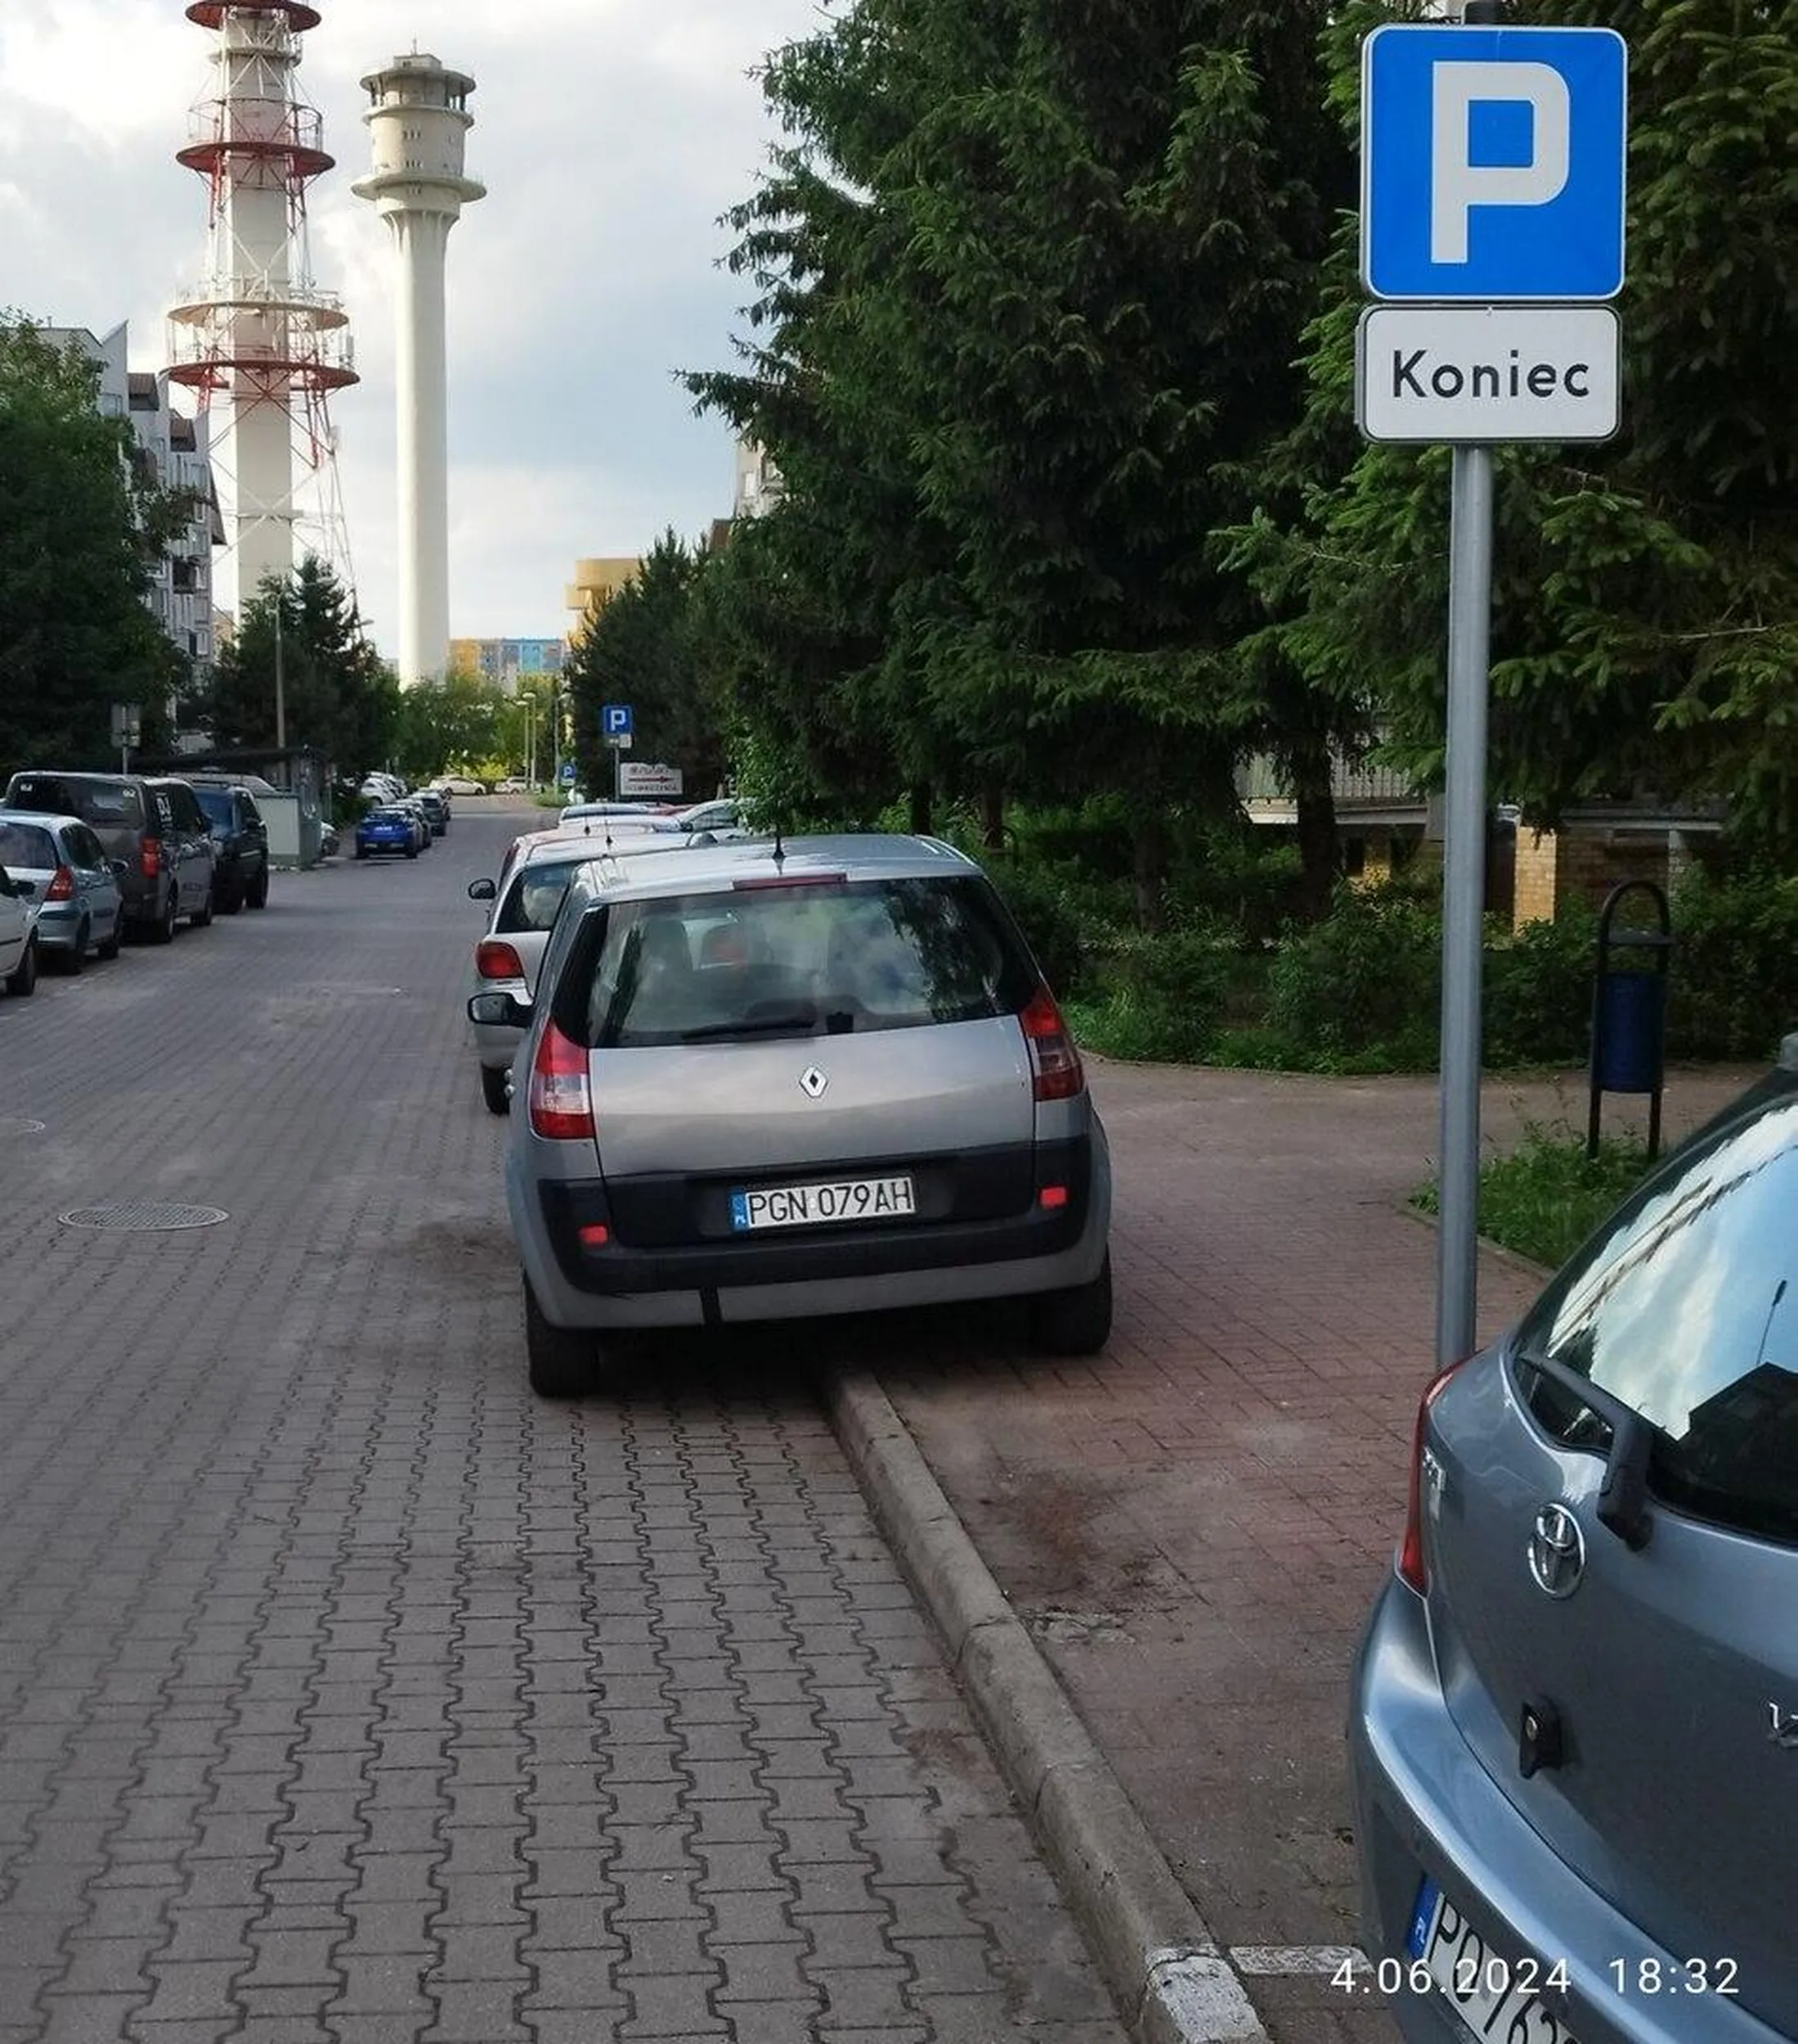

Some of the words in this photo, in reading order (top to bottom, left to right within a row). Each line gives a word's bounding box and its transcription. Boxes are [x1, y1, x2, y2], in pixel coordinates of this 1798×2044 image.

[1431, 61, 1570, 264] P
[1392, 349, 1590, 398] Koniec
[610, 709, 625, 731] P
[747, 1190, 809, 1225] PGN
[818, 1180, 912, 1217] 079AH
